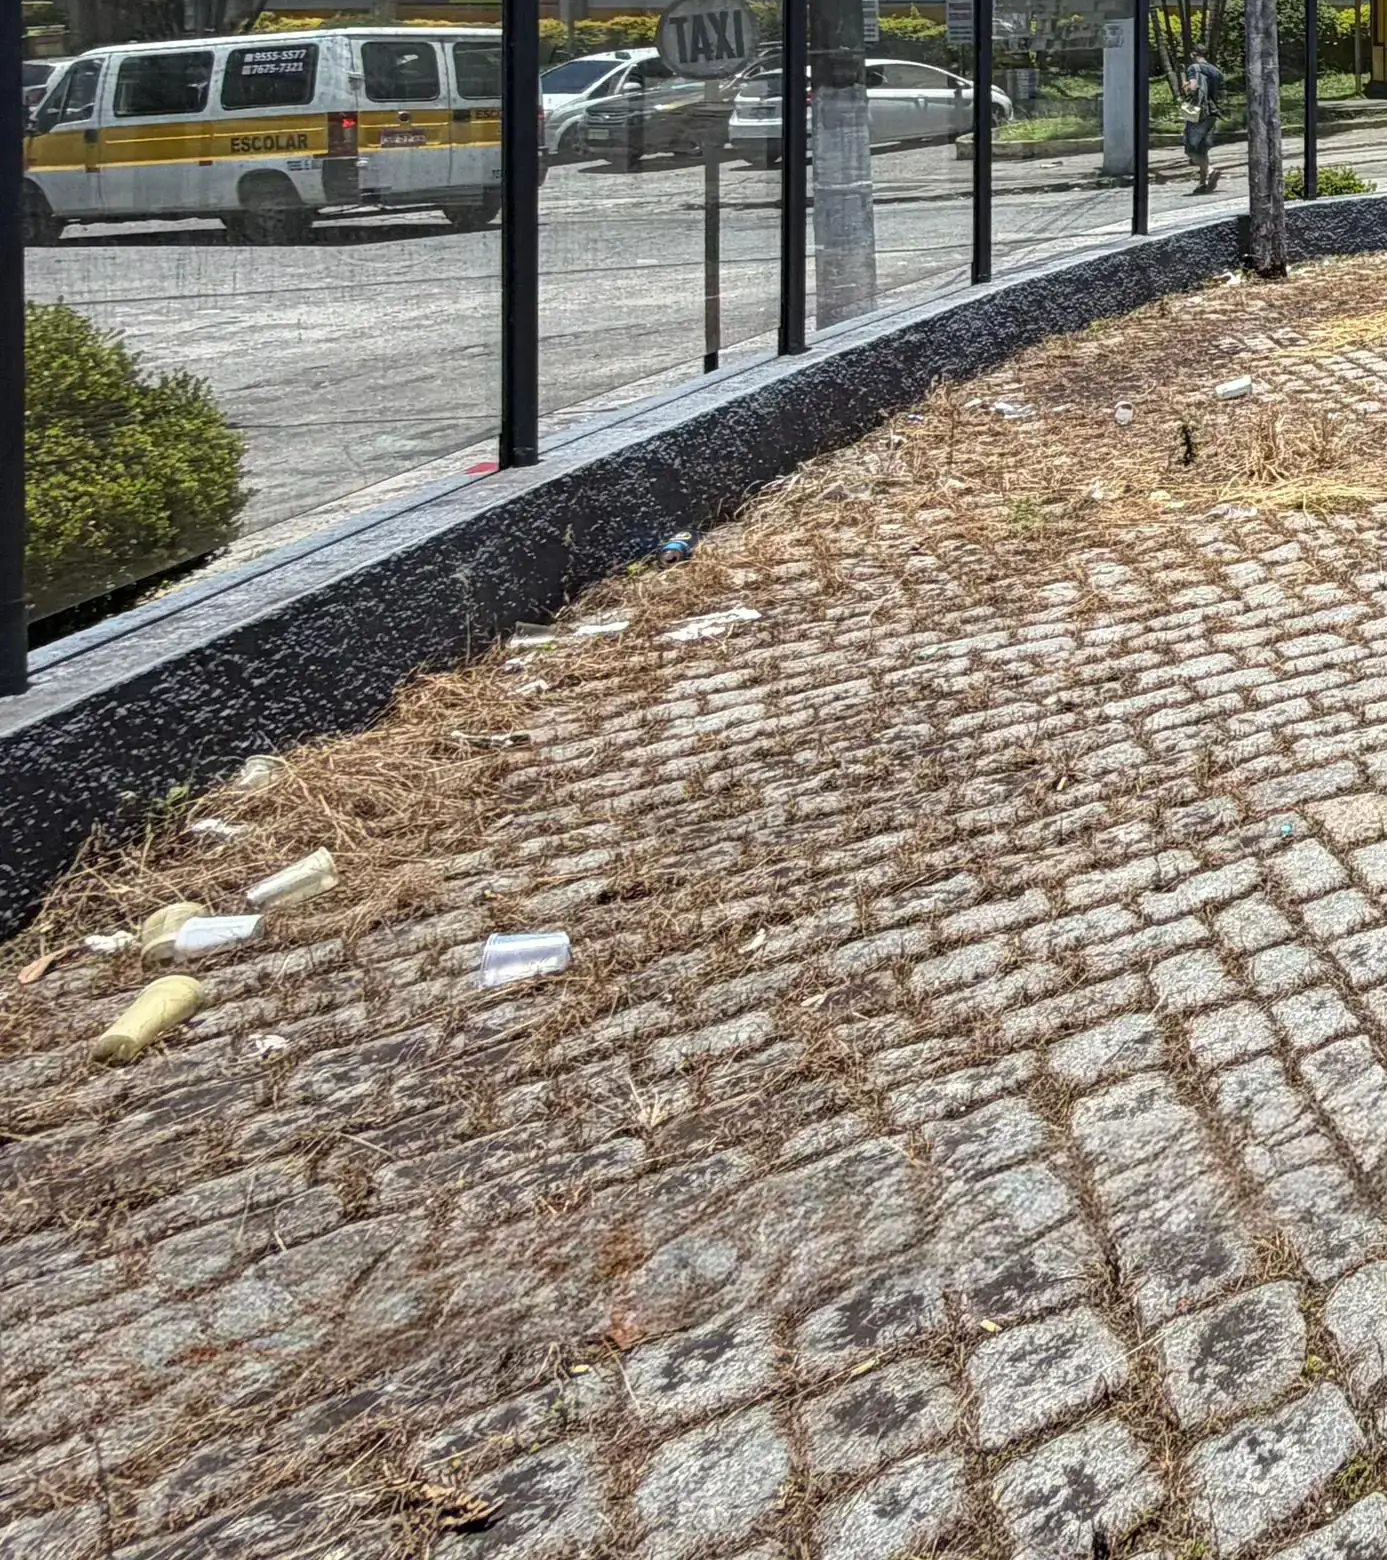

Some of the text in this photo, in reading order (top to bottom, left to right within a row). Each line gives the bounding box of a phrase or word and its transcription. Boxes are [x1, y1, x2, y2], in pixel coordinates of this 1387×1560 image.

[669, 8, 746, 64] TAXI
[254, 49, 307, 62] 9555-5577
[251, 62, 304, 75] 7675-7321
[230, 133, 309, 153] ESCOLAR
